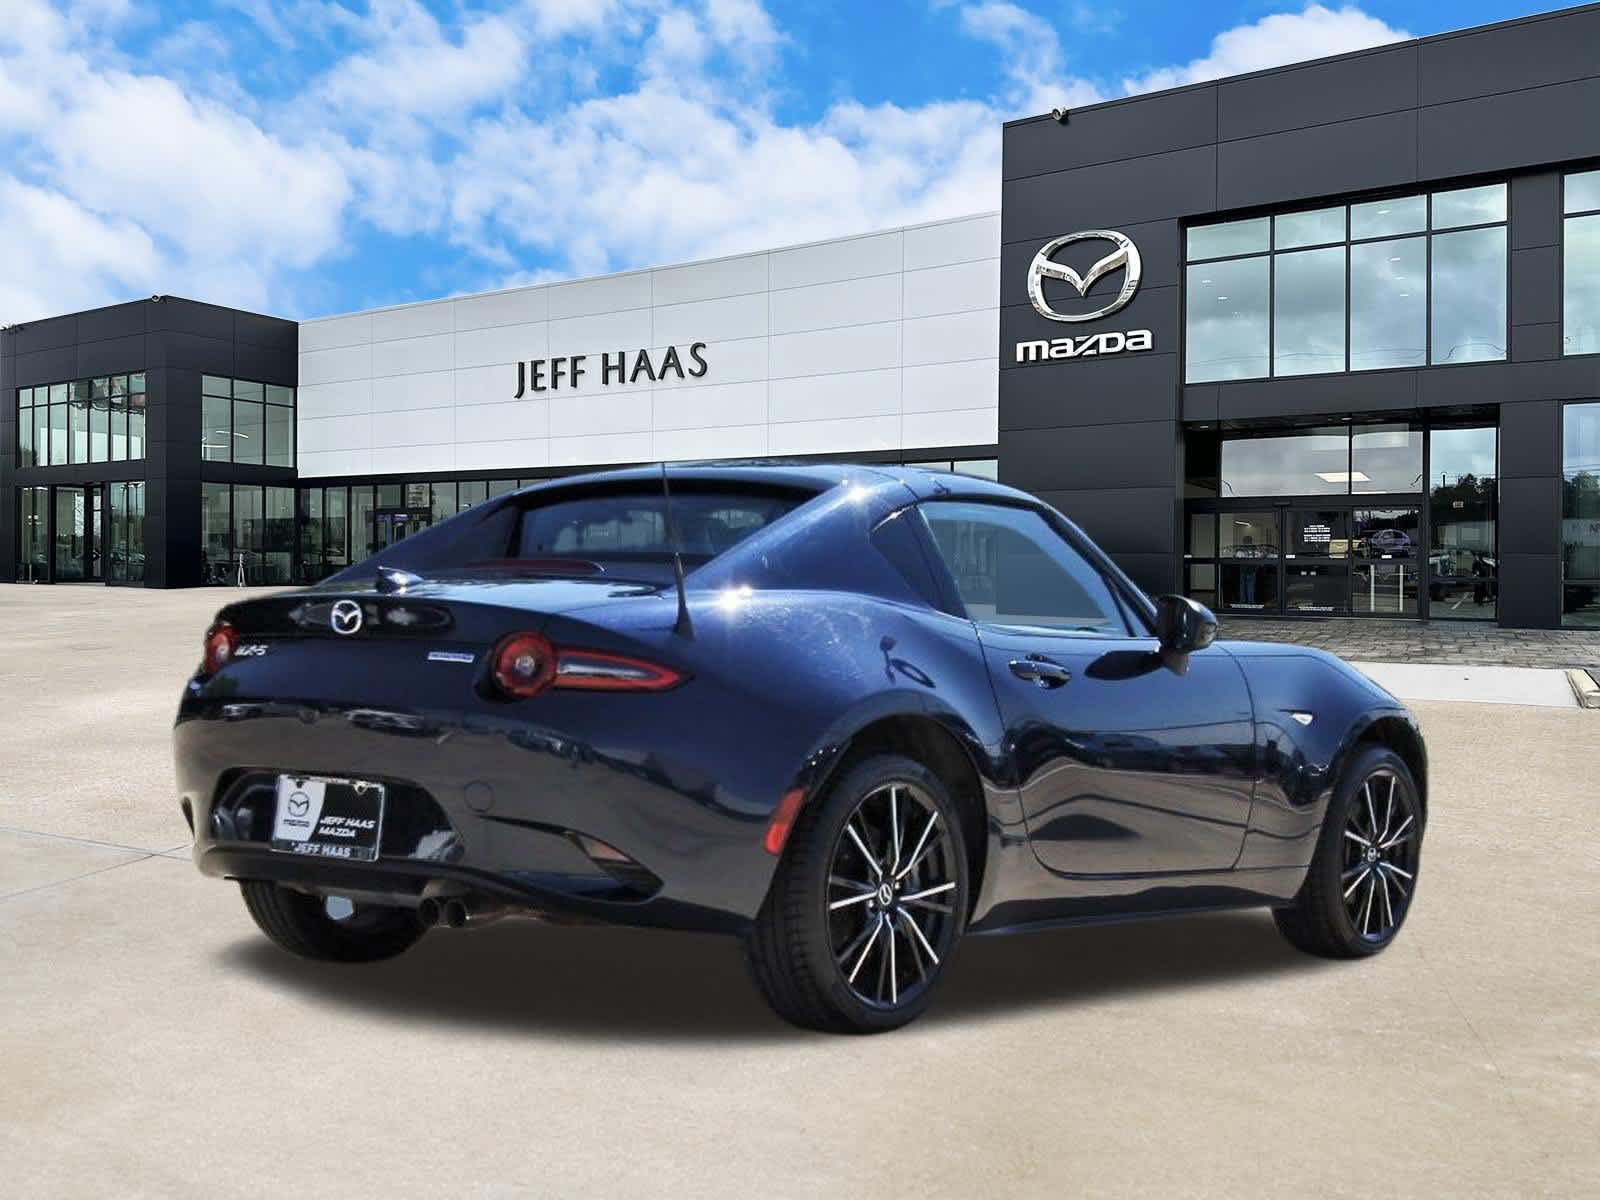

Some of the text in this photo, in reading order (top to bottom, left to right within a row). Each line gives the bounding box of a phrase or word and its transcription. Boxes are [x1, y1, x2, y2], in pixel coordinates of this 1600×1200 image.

[514, 342, 708, 399] JEFF HAAS
[320, 816, 345, 825] JEFF
[345, 818, 376, 829] HAAS
[319, 827, 356, 837] MAZDA
[294, 843, 351, 858] JEFF HAAS
